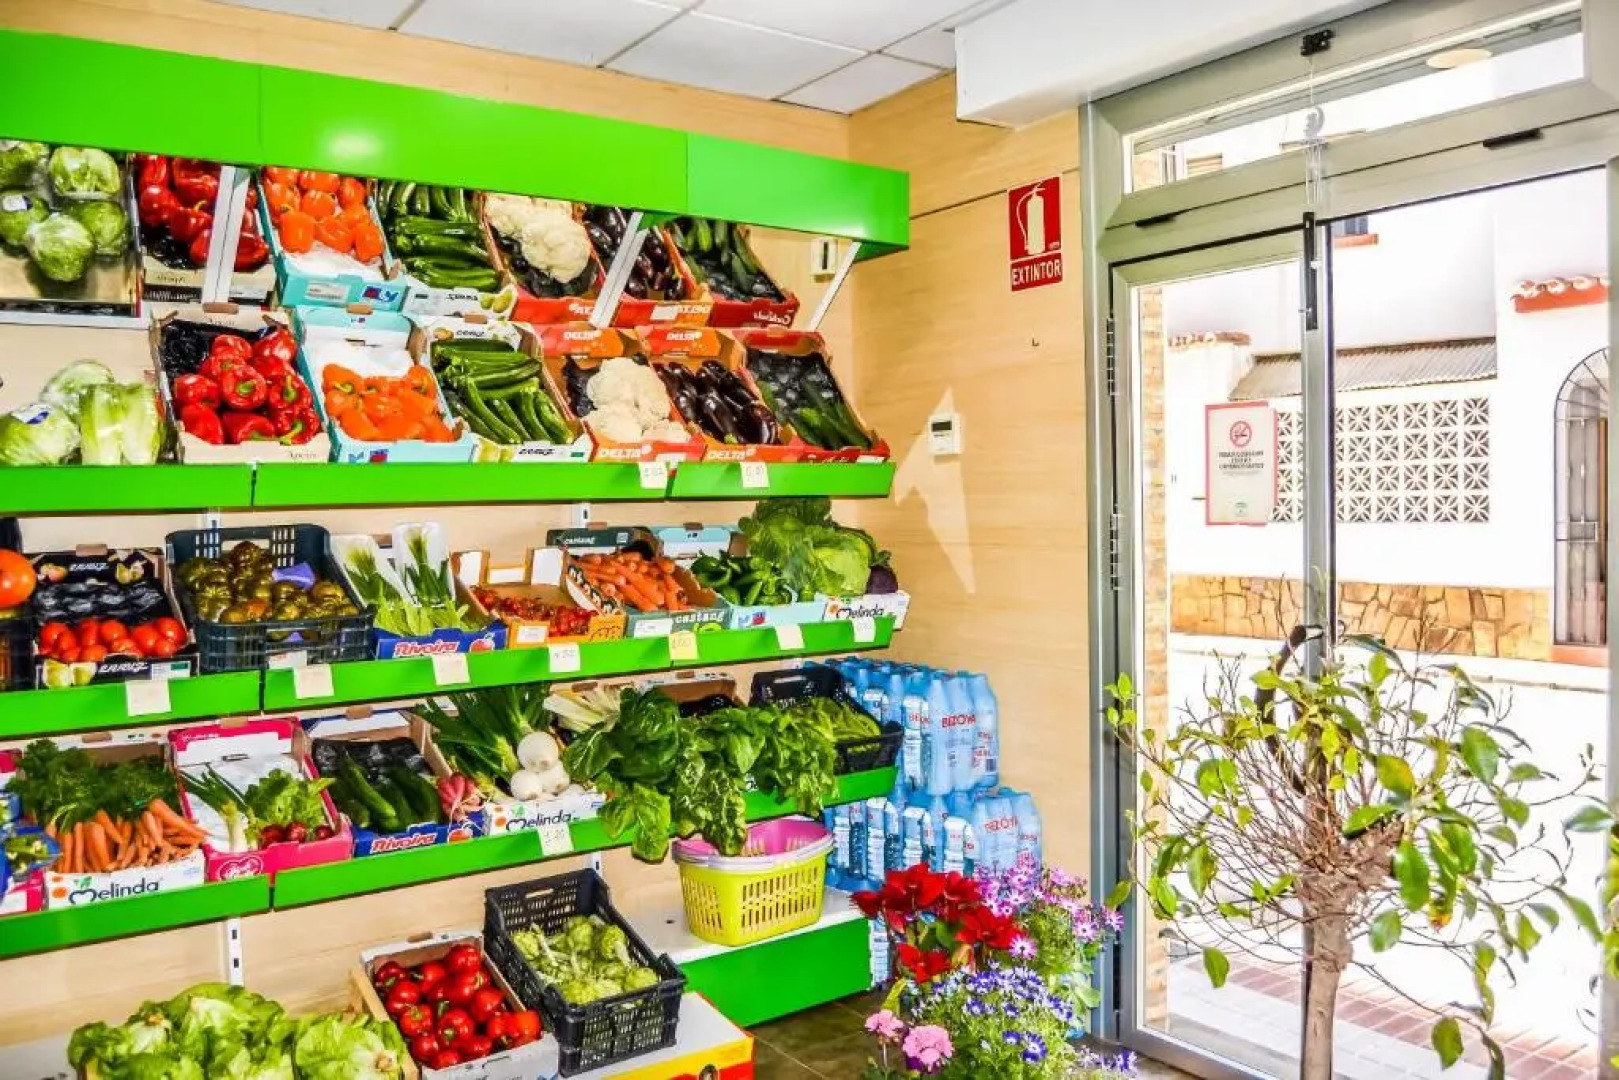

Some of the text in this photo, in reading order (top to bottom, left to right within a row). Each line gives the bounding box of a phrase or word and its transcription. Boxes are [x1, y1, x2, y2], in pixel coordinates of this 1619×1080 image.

[1012, 260, 1062, 285] EXTINTOR
[394, 639, 459, 658] Rivoira
[506, 809, 572, 831] Melinda
[371, 833, 437, 853] Rivoira
[69, 877, 159, 905] Melinda
